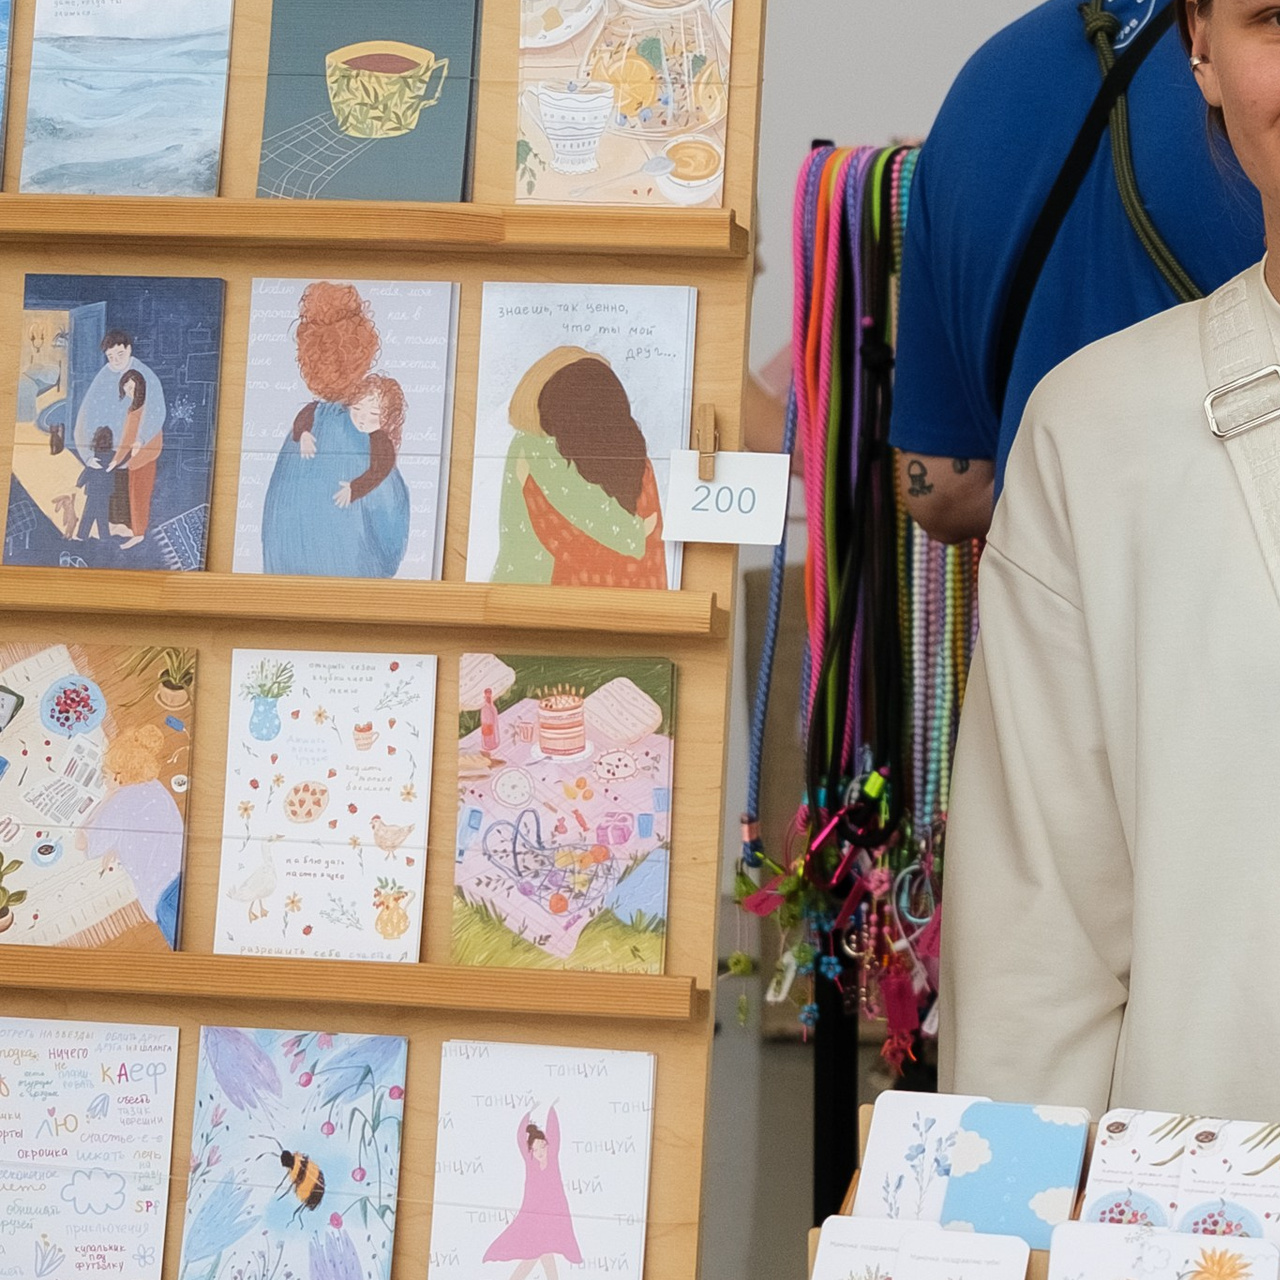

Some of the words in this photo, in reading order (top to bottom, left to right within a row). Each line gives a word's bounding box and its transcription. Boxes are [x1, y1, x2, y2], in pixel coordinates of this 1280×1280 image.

[499, 305, 553, 318] знаешь,
[556, 303, 579, 313] так
[585, 302, 629, 315] ценно,
[562, 322, 591, 333] что
[598, 324, 621, 335] ты
[628, 324, 656, 336] мой
[691, 484, 756, 514] 200
[17, 1147, 68, 1160] окрошка
